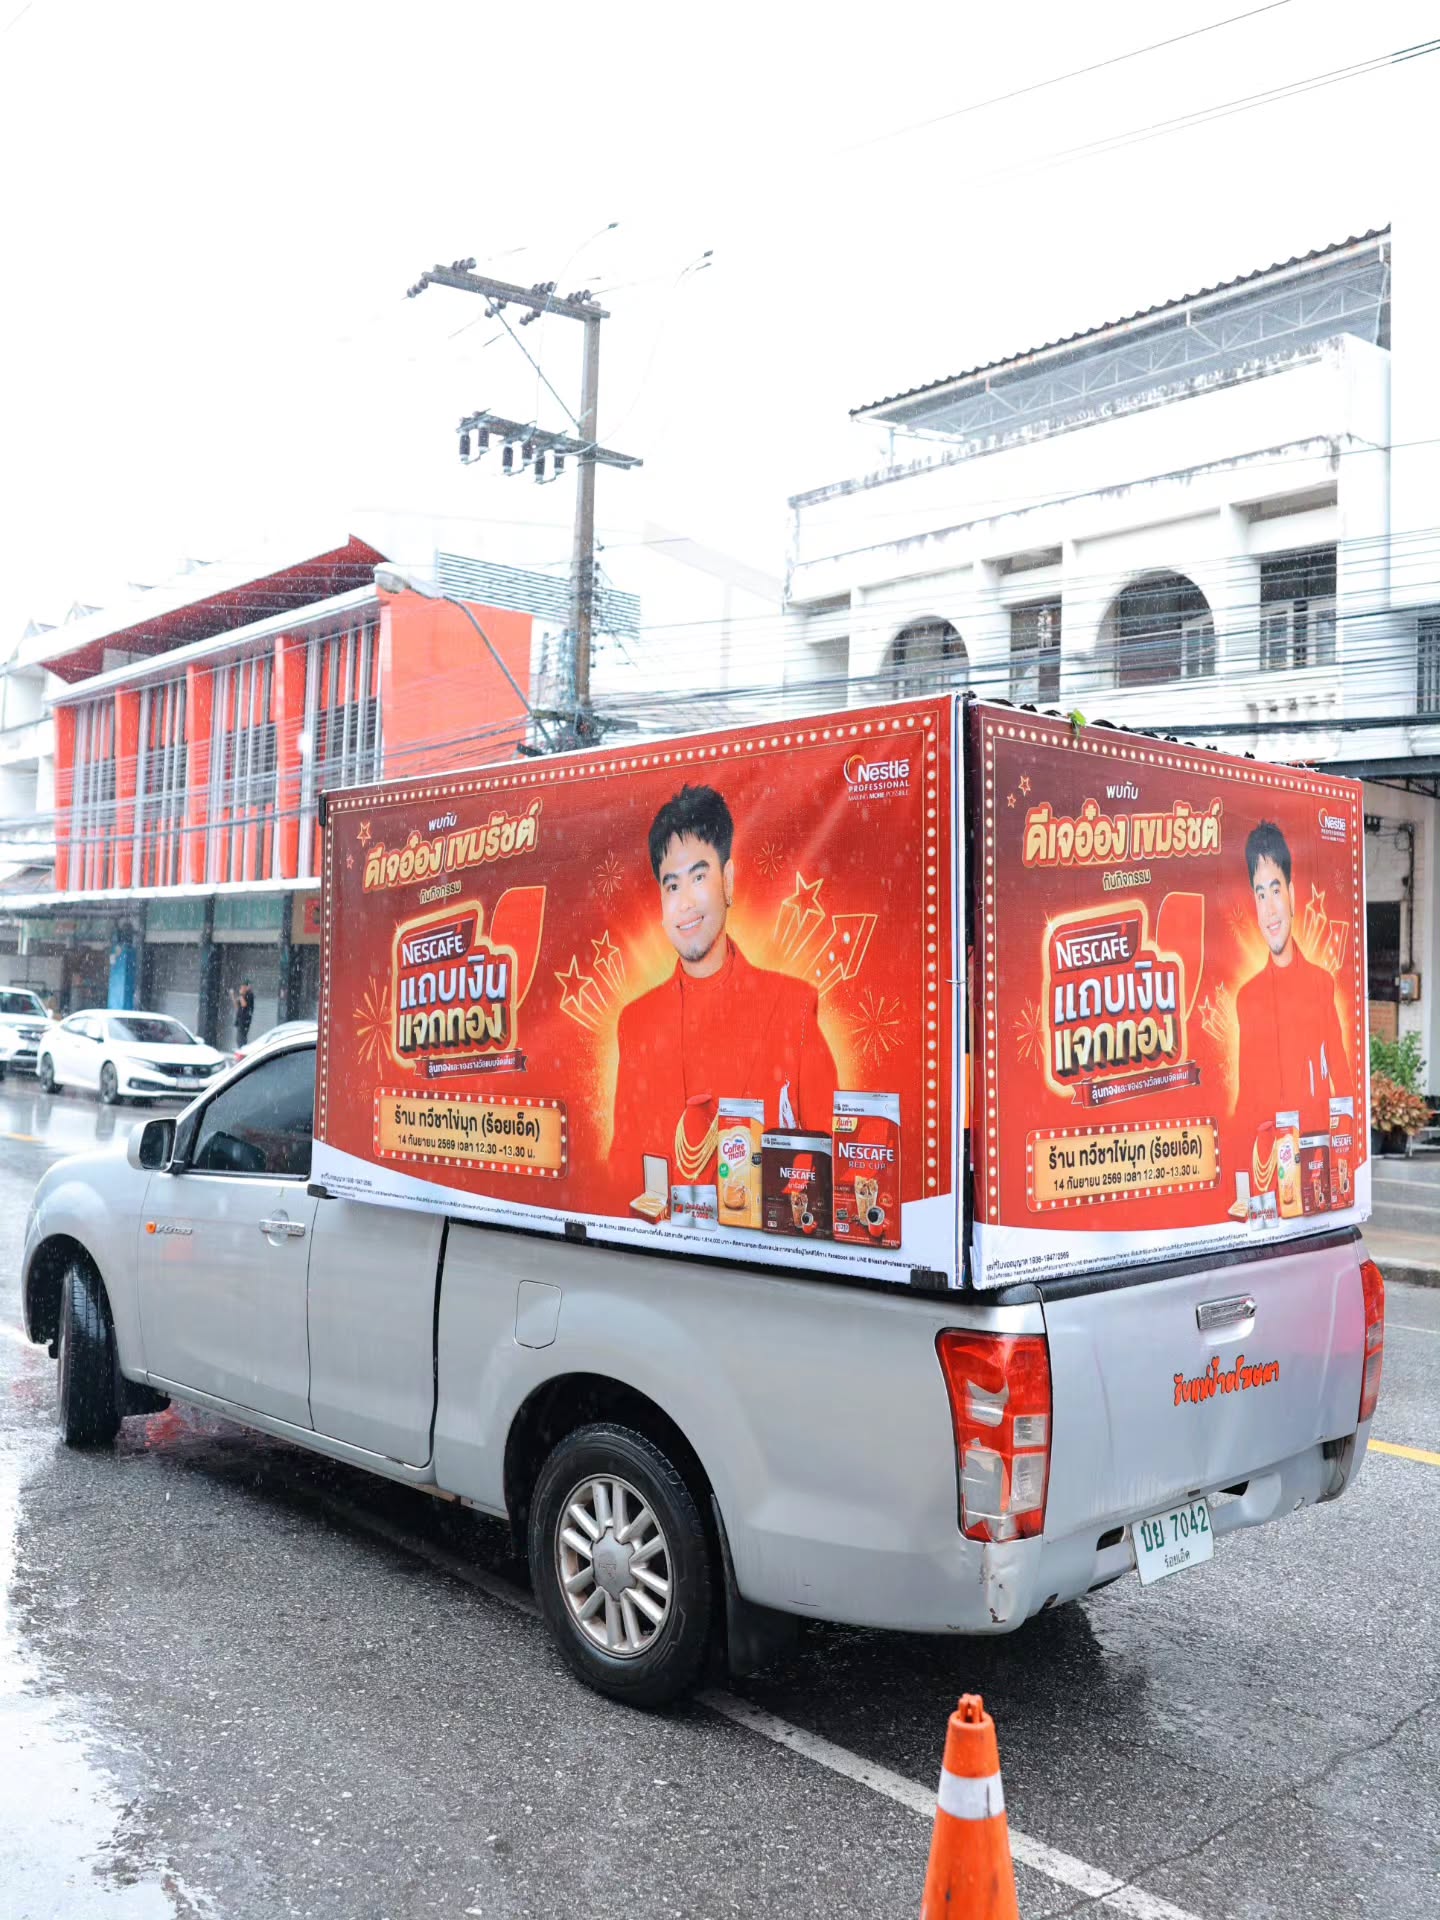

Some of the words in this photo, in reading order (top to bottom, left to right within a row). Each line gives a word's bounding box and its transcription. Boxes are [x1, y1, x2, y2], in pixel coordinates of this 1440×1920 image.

[858, 758, 910, 782] Nestlé
[848, 780, 910, 793] PROFESSIONAL
[1106, 780, 1139, 799] พบกับ
[428, 812, 458, 831] พบกับ
[419, 880, 462, 904] กับกิจกรรม
[1103, 869, 1152, 891] กับกิจกรรม
[400, 954, 507, 1011] แถบเงิน
[1055, 960, 1176, 1025] แถบเงิน
[399, 1003, 505, 1051] แจกทอง
[1055, 1014, 1175, 1073] แจกทอง
[394, 1104, 416, 1125] ร้าน
[419, 1107, 478, 1138] ทวีชาไข่มุก
[481, 1111, 541, 1142] (ร้อยเอ็ด)
[398, 1134, 407, 1145] 14
[408, 1133, 436, 1147] กันยายน
[437, 1138, 456, 1150] 2569
[457, 1141, 474, 1152] เวลา
[527, 1149, 536, 1159] น.
[722, 1142, 745, 1155] Coffee
[728, 1149, 746, 1161] mate
[1049, 1145, 1075, 1169] ร้าน
[1079, 1138, 1146, 1168] ทวีชาไข่มุก
[1150, 1131, 1203, 1164] (ร้อยเอ็ด)
[848, 1161, 866, 1170] RED
[869, 1162, 887, 1171] CUP
[1054, 1179, 1065, 1191] 14
[1067, 1175, 1100, 1190] กันยายน
[1102, 1172, 1122, 1186] 2569
[1124, 1171, 1142, 1183] เวลา
[1192, 1164, 1200, 1175] น.
[1169, 1505, 1209, 1541] 7042
